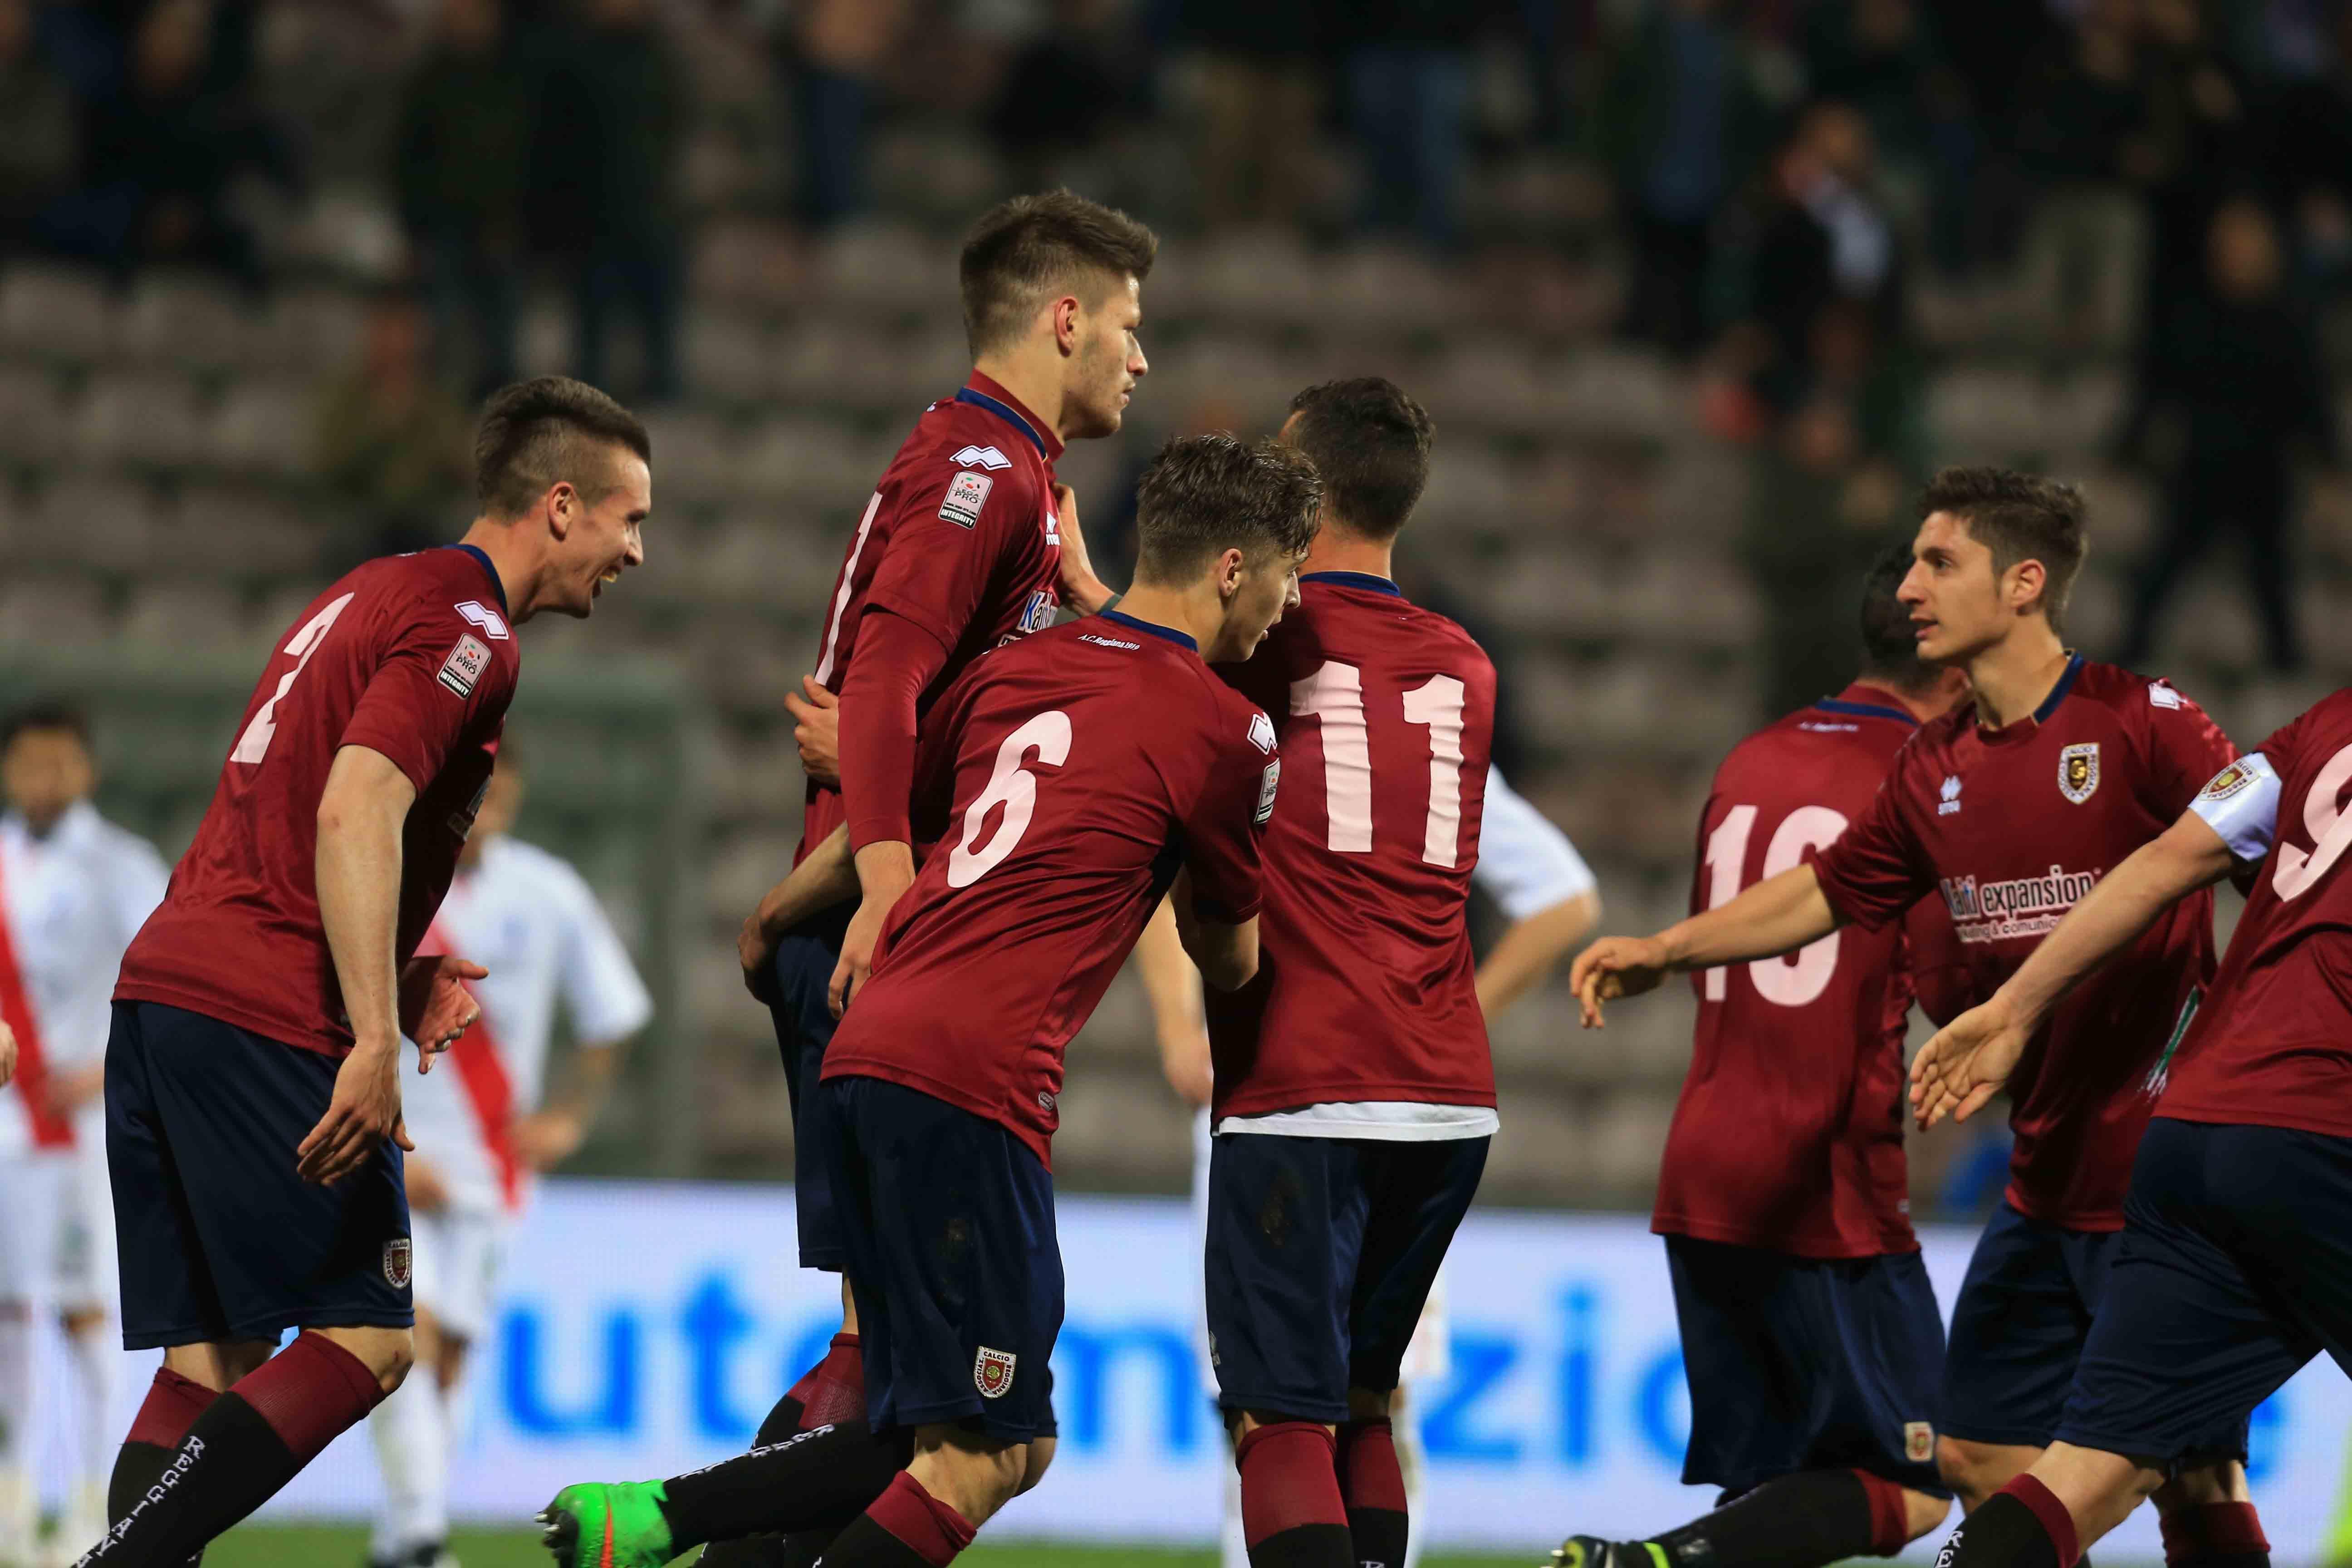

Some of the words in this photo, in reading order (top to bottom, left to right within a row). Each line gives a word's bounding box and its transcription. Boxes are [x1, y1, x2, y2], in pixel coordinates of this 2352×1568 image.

[955, 491, 978, 504] PRO
[941, 509, 974, 526] INTEGRITY
[229, 591, 355, 764] 2
[440, 670, 469, 696] INTEGRITY
[1289, 660, 1465, 869] 11
[947, 710, 1073, 888] 6
[984, 1352, 1009, 1362] CALCIO
[993, 1364, 1012, 1395] REGGIANA
